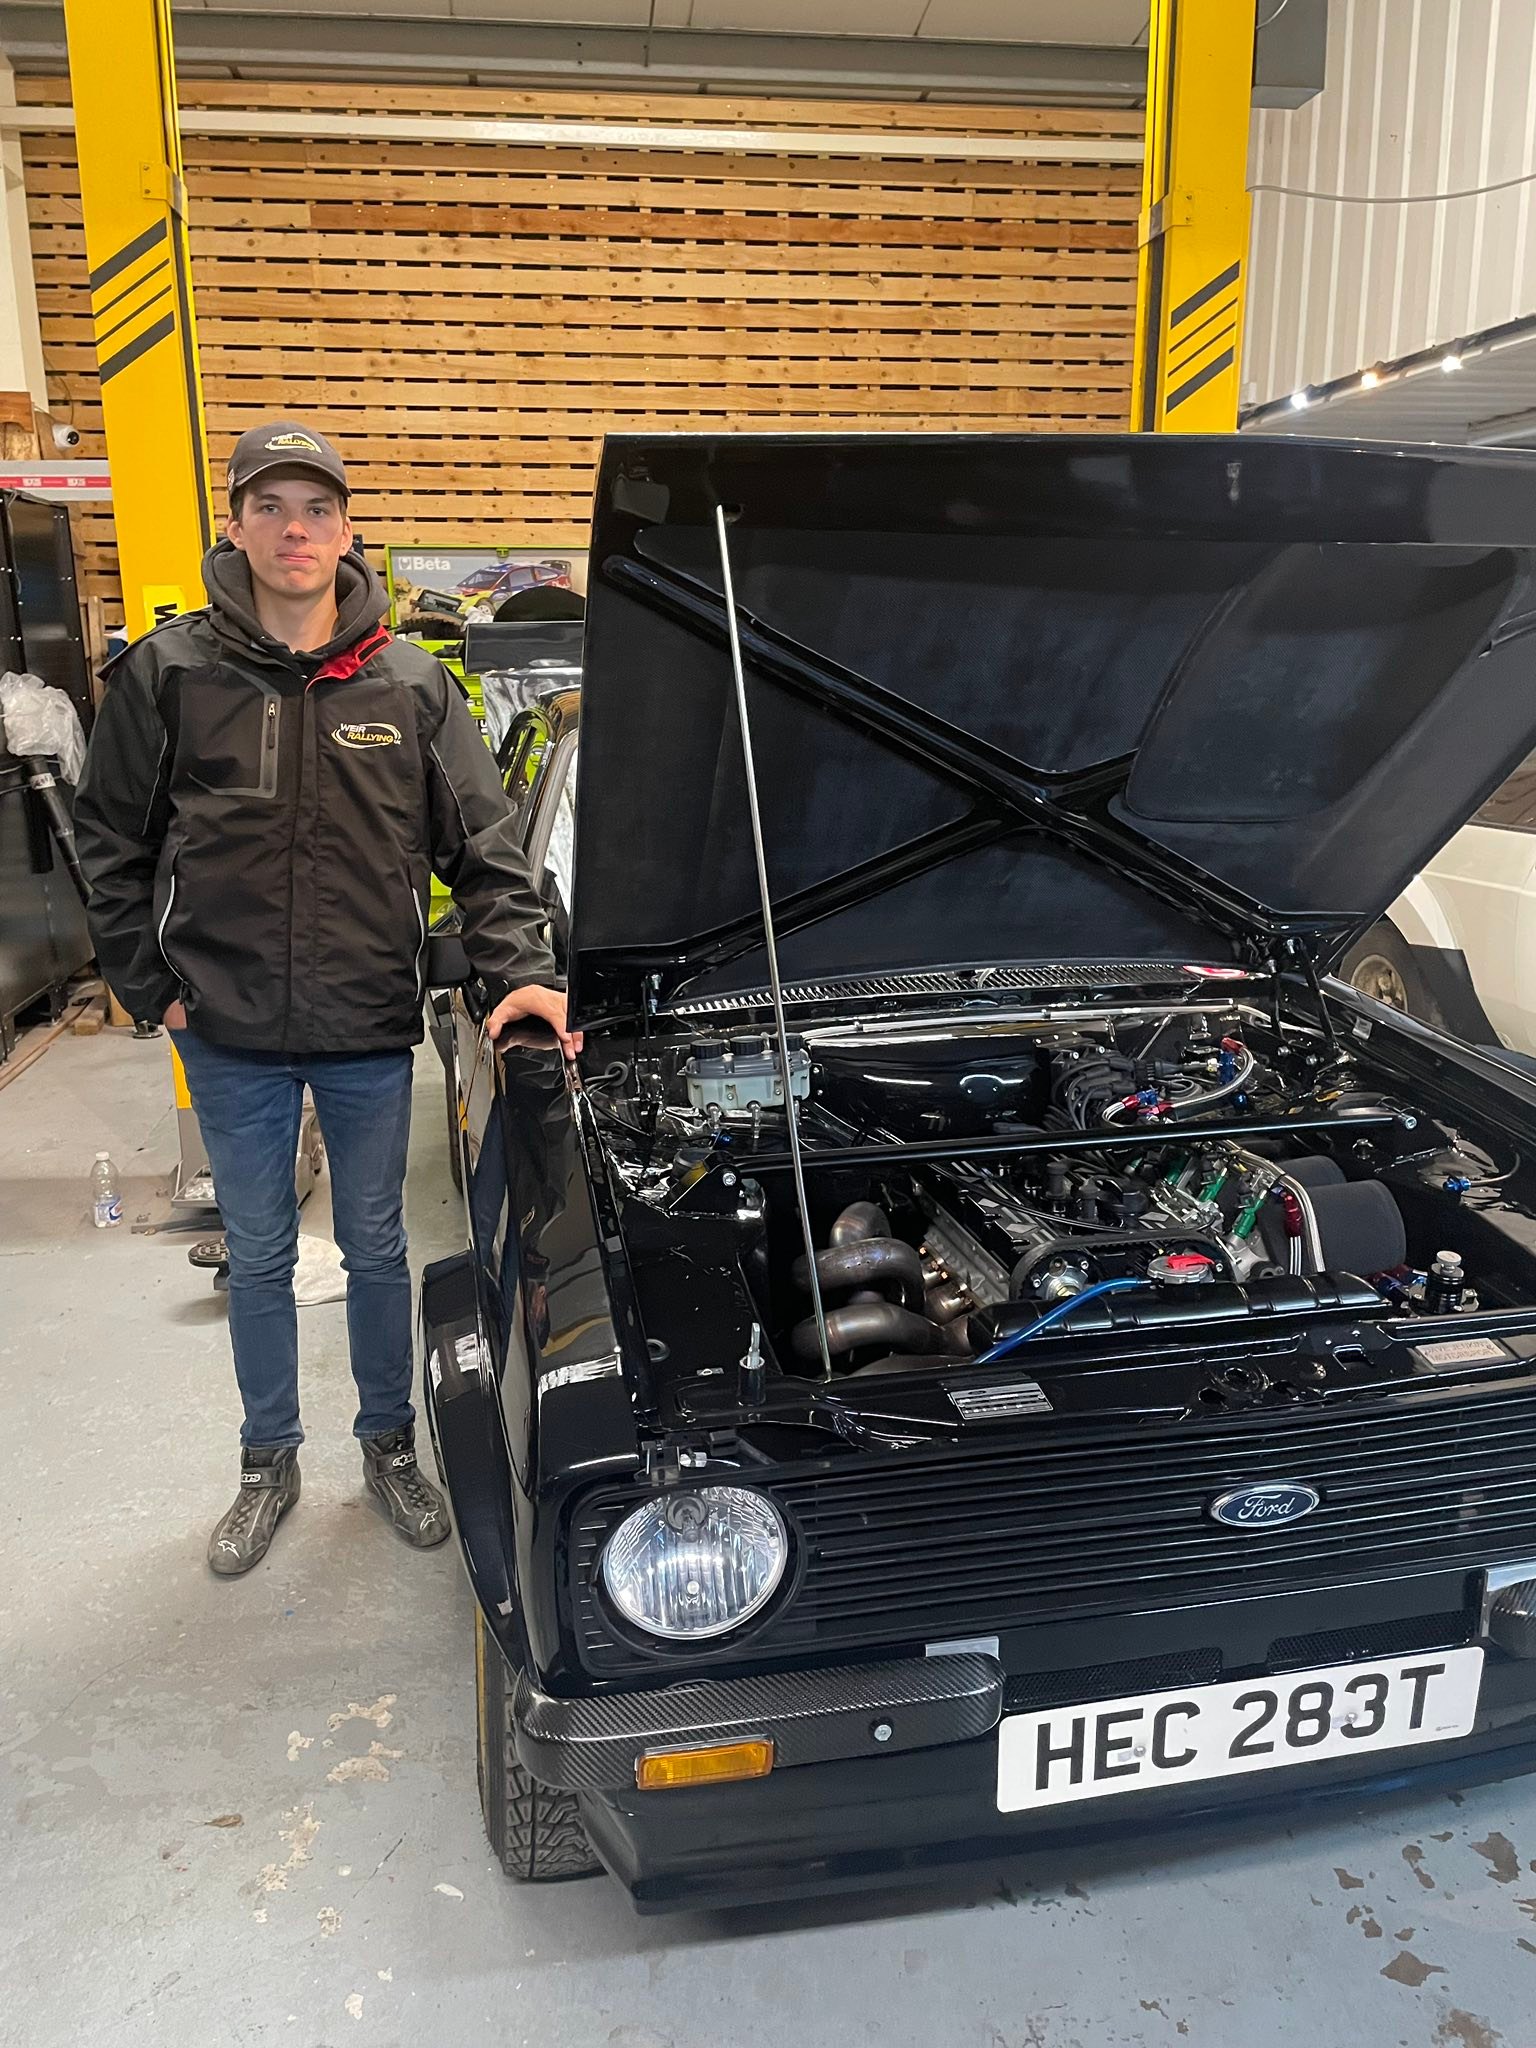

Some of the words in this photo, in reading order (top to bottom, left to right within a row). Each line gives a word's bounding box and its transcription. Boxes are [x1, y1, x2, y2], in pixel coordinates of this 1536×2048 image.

[413, 557, 451, 571] Beta
[340, 723, 366, 733] WEIR
[347, 732, 394, 743] RALLYING
[1237, 1494, 1296, 1519] Ford
[1035, 1701, 1200, 1791] HEC
[1228, 1663, 1445, 1759] 283T
